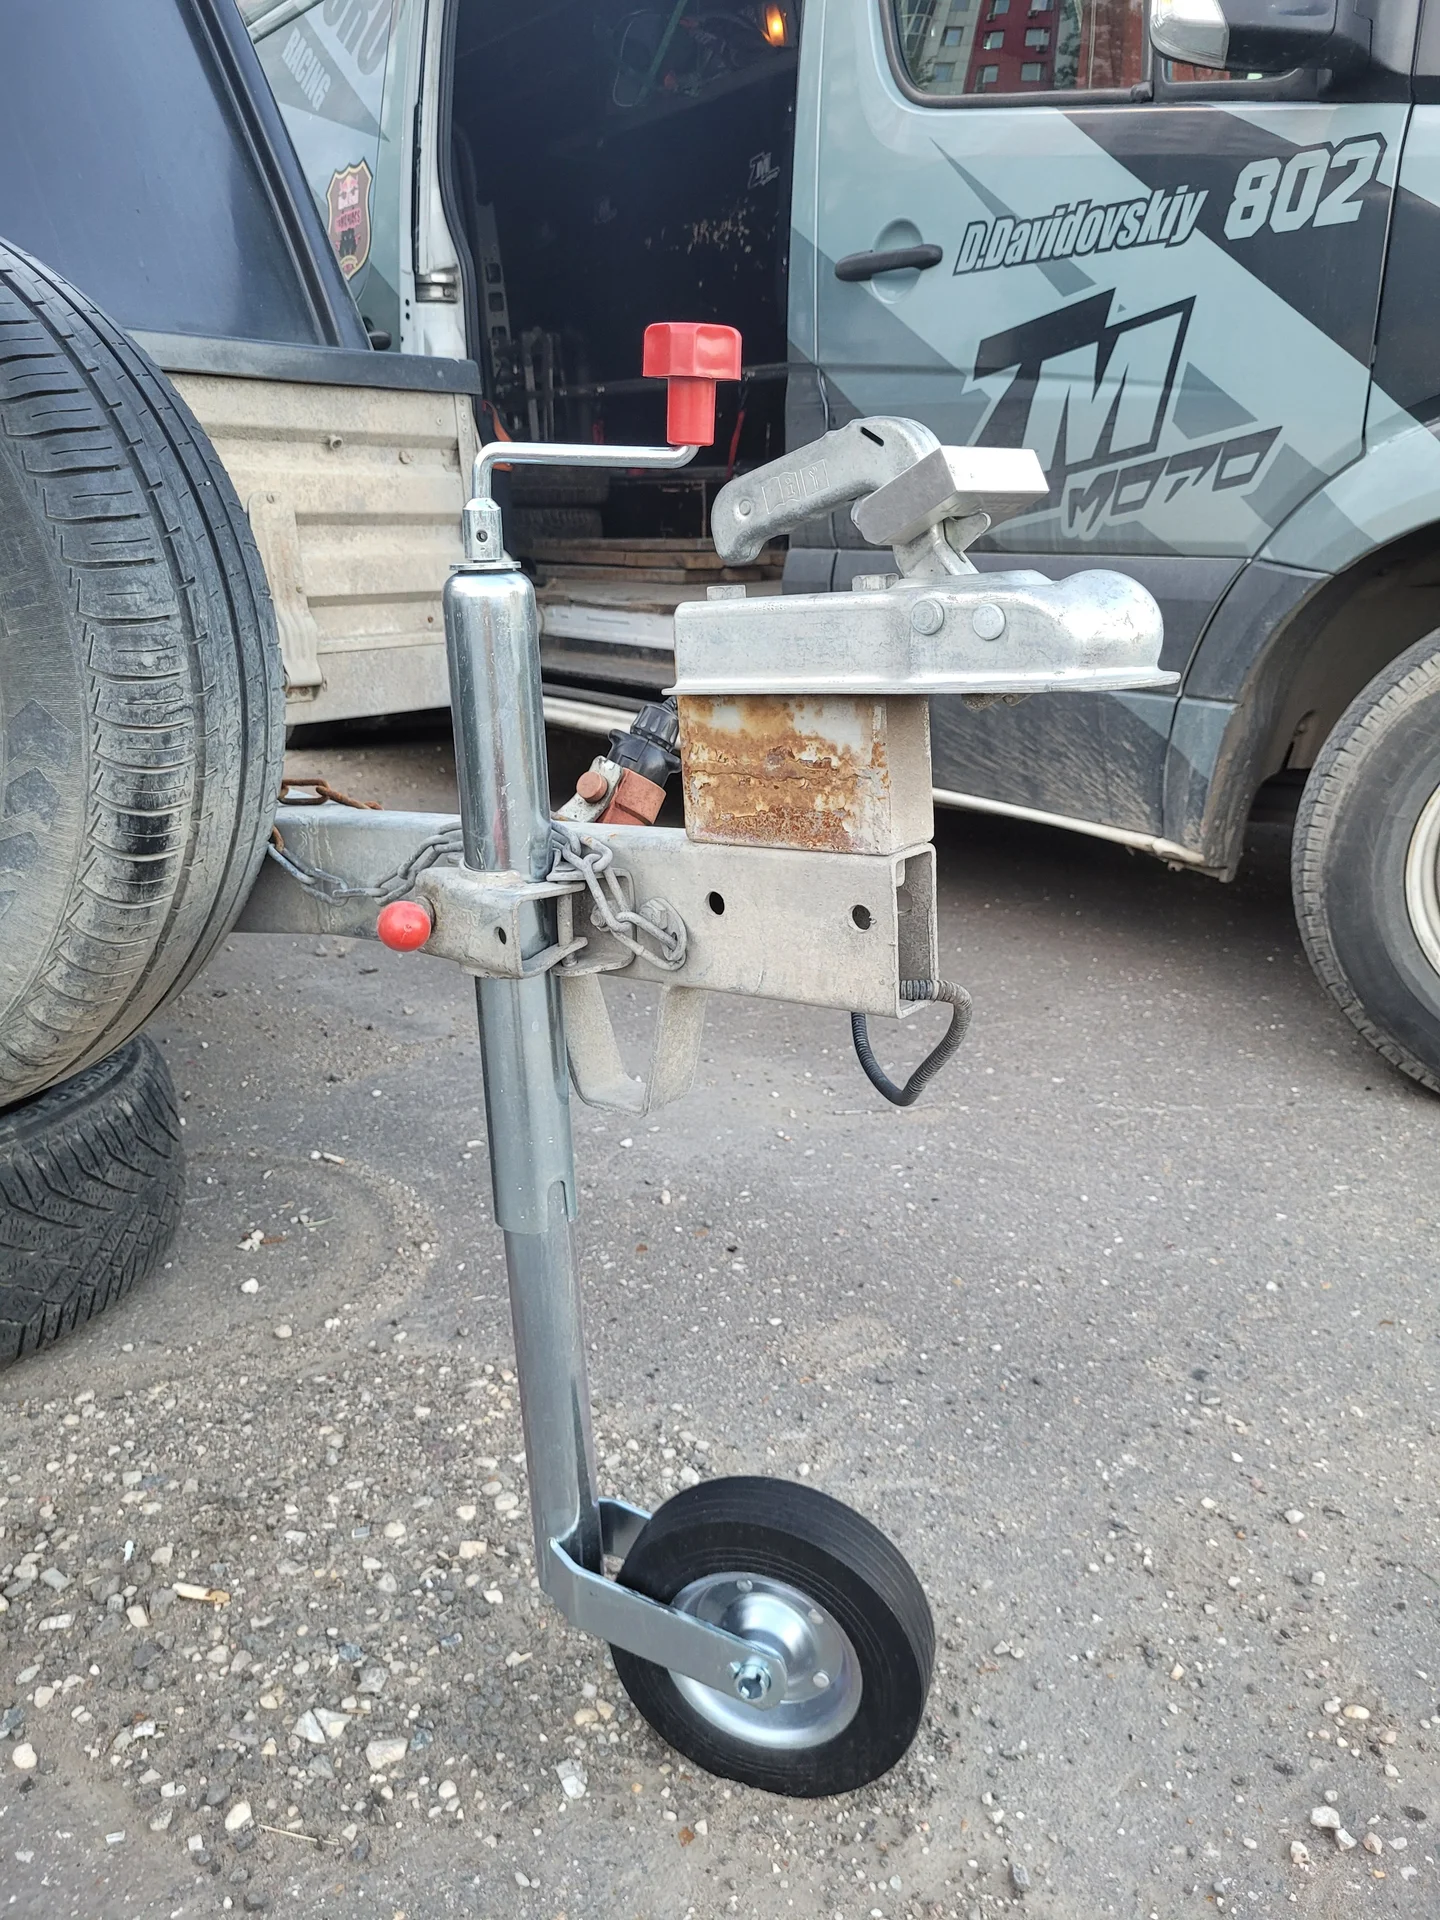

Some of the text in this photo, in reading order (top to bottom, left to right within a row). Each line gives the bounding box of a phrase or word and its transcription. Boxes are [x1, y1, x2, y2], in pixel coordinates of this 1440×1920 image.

[281, 26, 331, 111] RACING
[953, 134, 1386, 276] D.Davidovskiy 802
